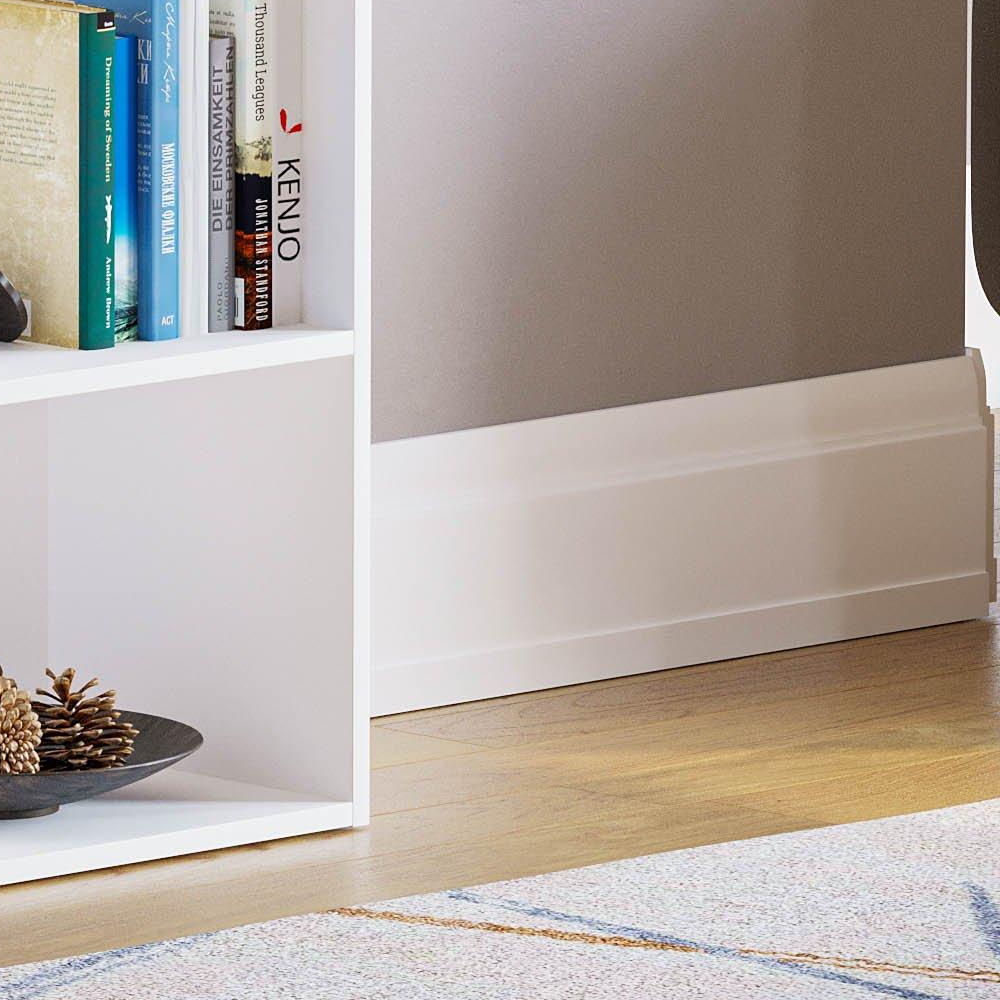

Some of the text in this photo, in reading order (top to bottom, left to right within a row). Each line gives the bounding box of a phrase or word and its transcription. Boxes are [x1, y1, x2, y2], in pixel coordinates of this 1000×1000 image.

[104, 56, 112, 117] Dreaming
[252, 3, 268, 122] Thousand Leagues
[105, 119, 112, 132] of
[212, 65, 223, 232] DIE EINSAMKEIT
[225, 46, 234, 231] DER PRIMZAHLEN
[161, 143, 175, 255] МОСКОВСКИЕ ФИАЛКИ
[277, 158, 300, 262] KENJO
[255, 198, 268, 322] JONATHAN STANDFORD
